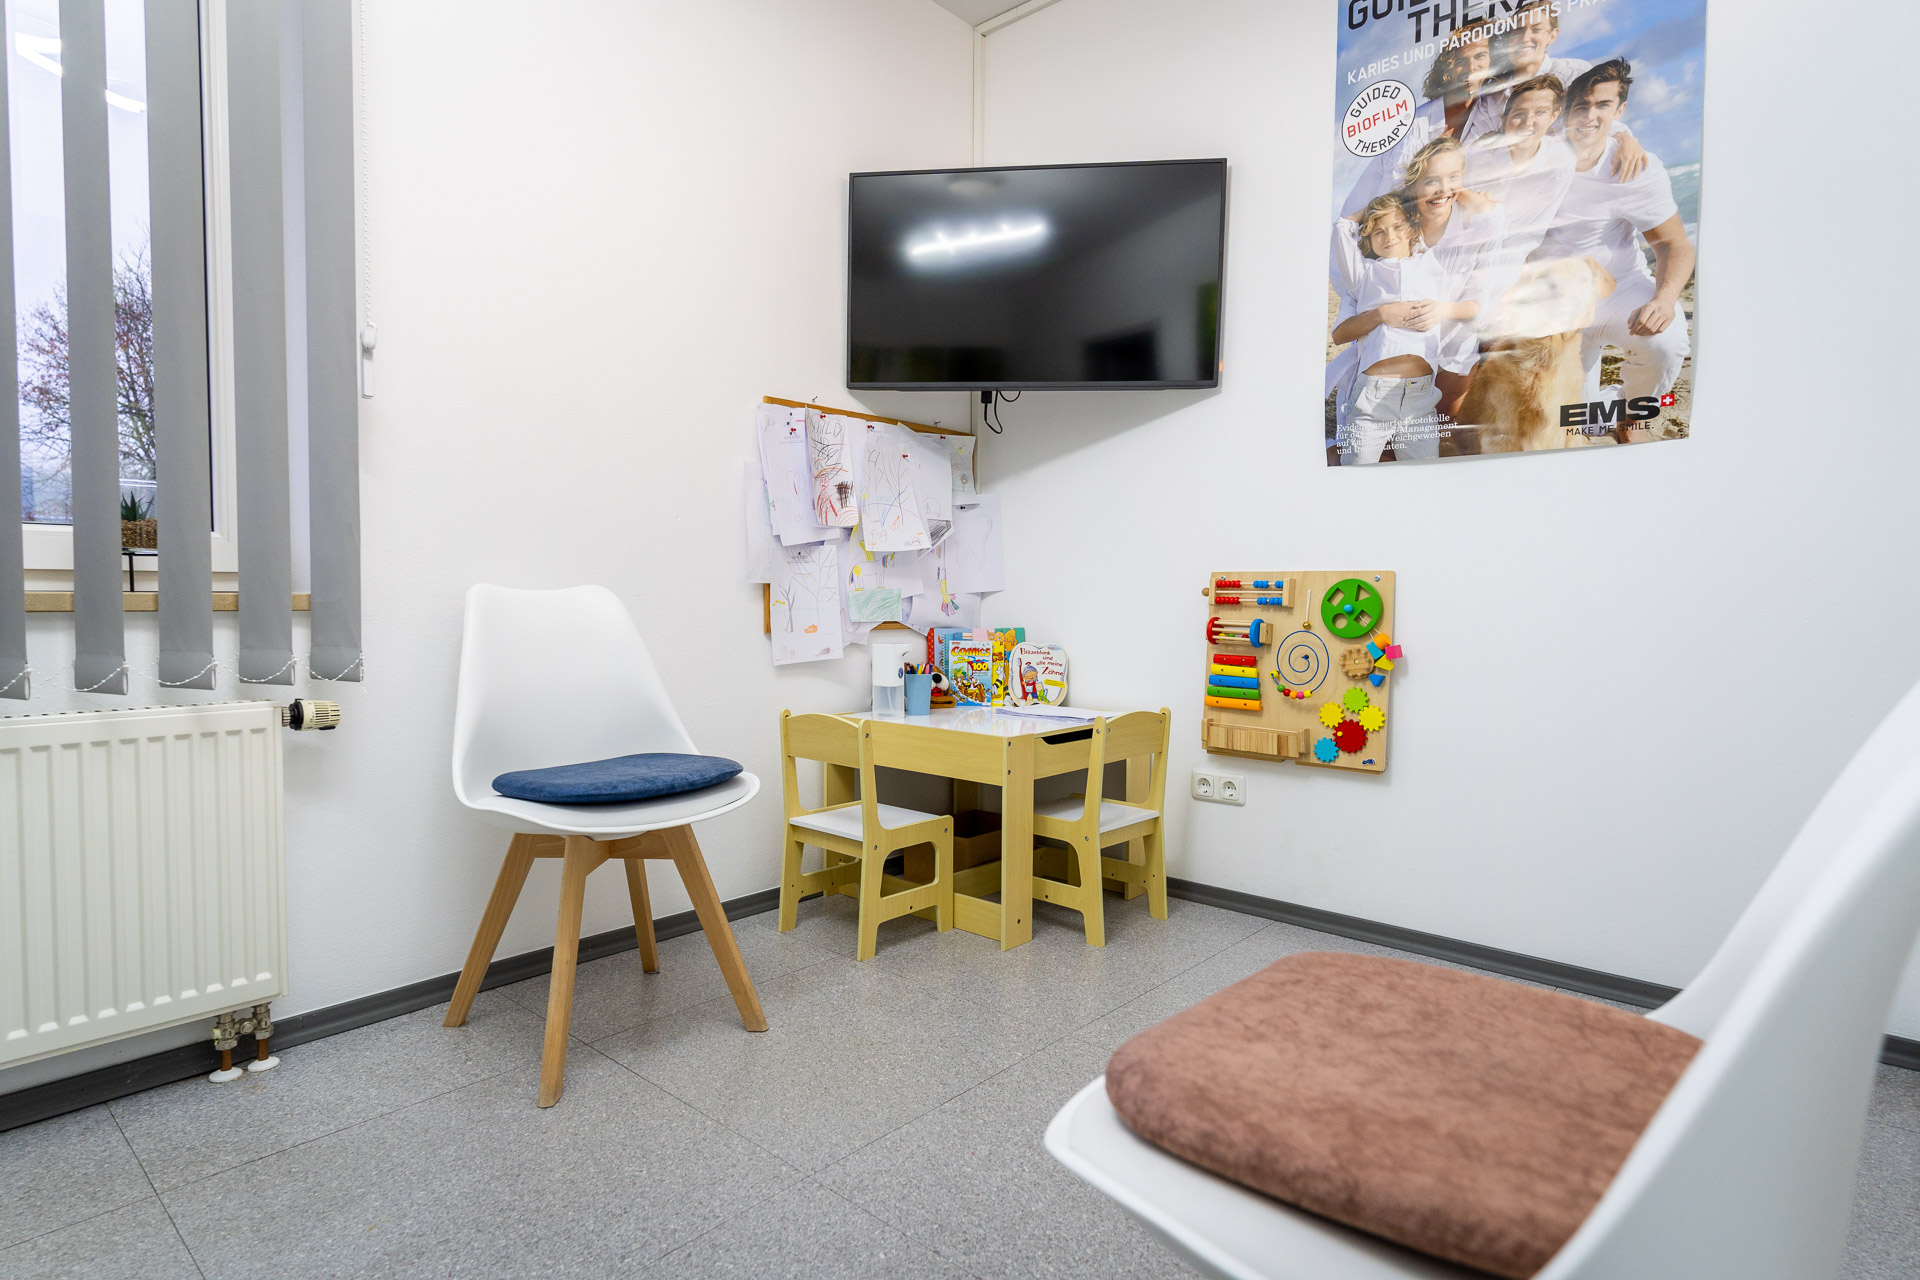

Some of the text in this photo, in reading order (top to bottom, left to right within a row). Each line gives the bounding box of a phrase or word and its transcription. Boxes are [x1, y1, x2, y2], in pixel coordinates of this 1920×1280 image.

[1347, 55, 1399, 85] KARIES
[1403, 43, 1435, 65] UND
[1440, 4, 1562, 54] PARODONTITIS
[1350, 85, 1401, 118] GUIDED
[1347, 99, 1408, 138] BIOFILM
[1355, 119, 1407, 153] THERAPY
[1406, 413, 1450, 425] Protokolle
[1560, 396, 1661, 427] EMS
[1566, 421, 1654, 436] MAKE ME SMILE.
[1336, 440, 1350, 448] auf
[1337, 447, 1352, 455] und
[972, 663, 988, 671] 100
